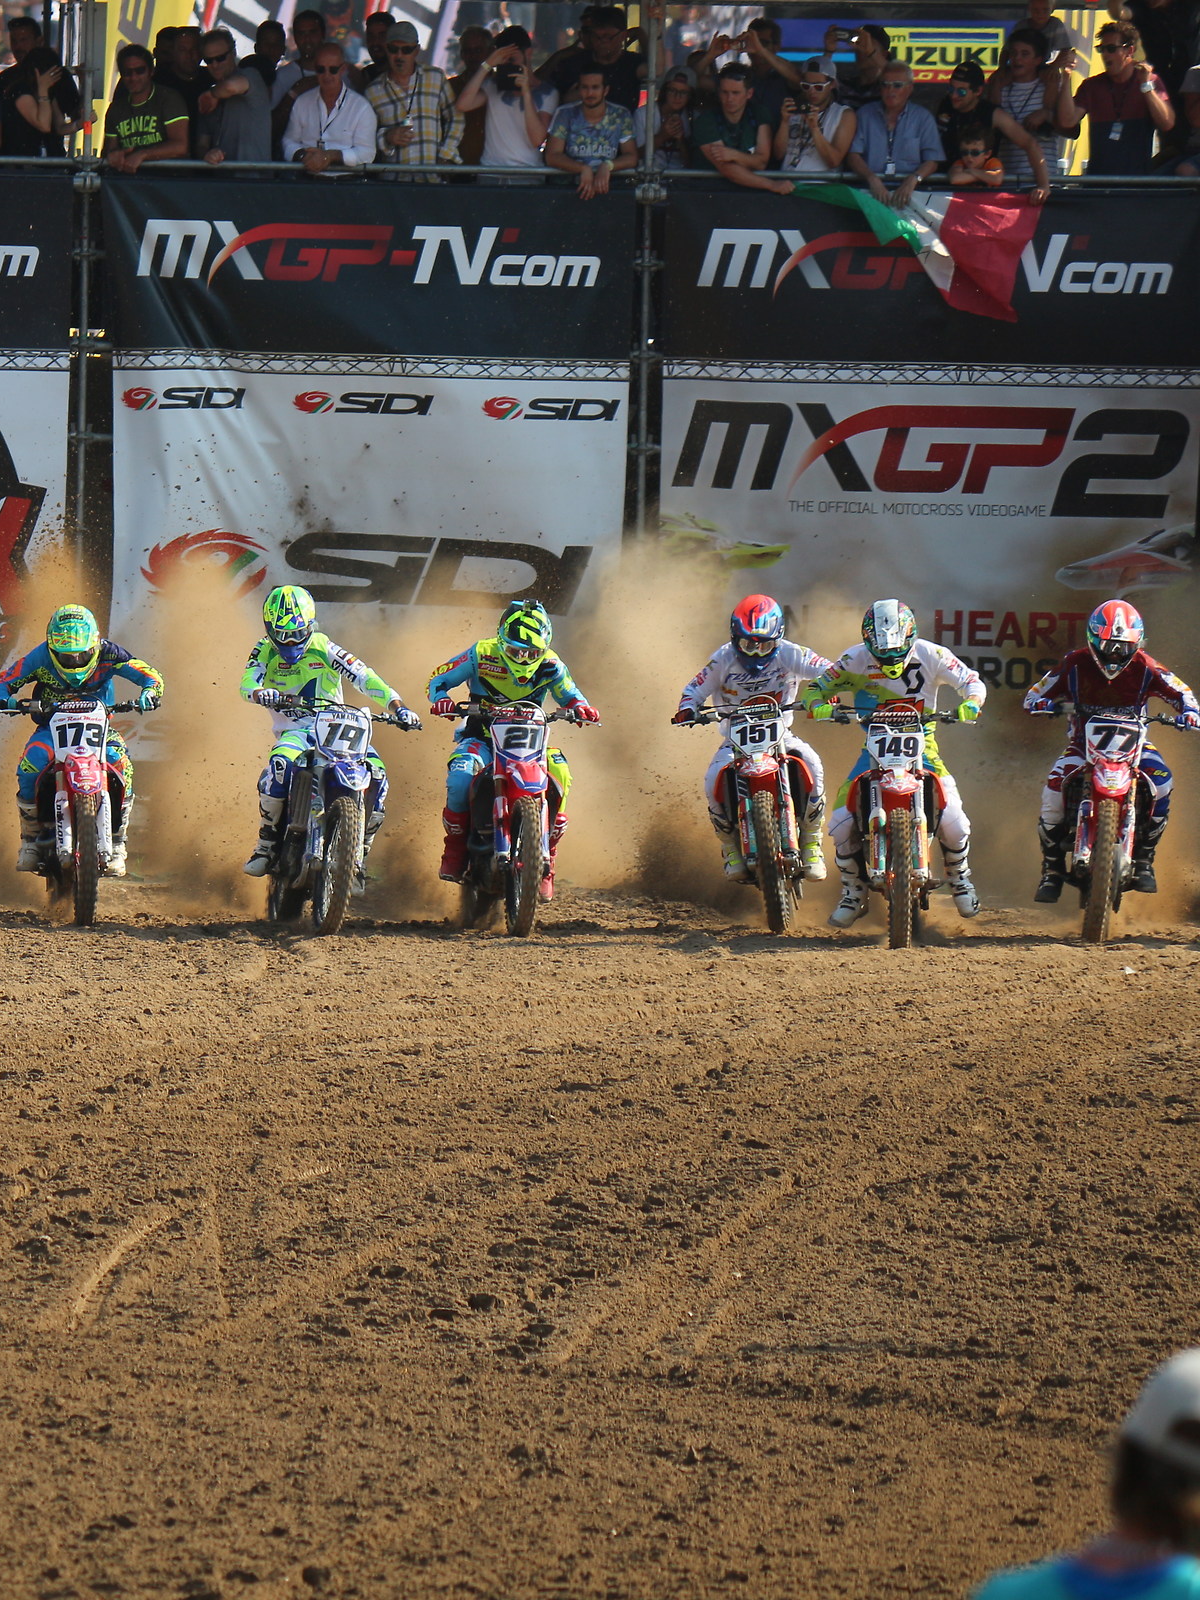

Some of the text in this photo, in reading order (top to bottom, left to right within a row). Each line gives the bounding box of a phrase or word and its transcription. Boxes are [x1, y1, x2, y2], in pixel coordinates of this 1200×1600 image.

[891, 46, 1000, 67] UZUKI
[789, 500, 1046, 517] THE OFFICIAL MOTOCROSS VIDEOGAME
[934, 609, 1089, 648] HEART
[331, 658, 357, 683] YAMA
[332, 712, 359, 723] YAMAHA
[56, 723, 104, 749] 173
[322, 722, 367, 751] 19
[502, 726, 540, 750] 21
[736, 722, 778, 747] 151
[1092, 726, 1138, 751] 77
[875, 736, 919, 759] 149
